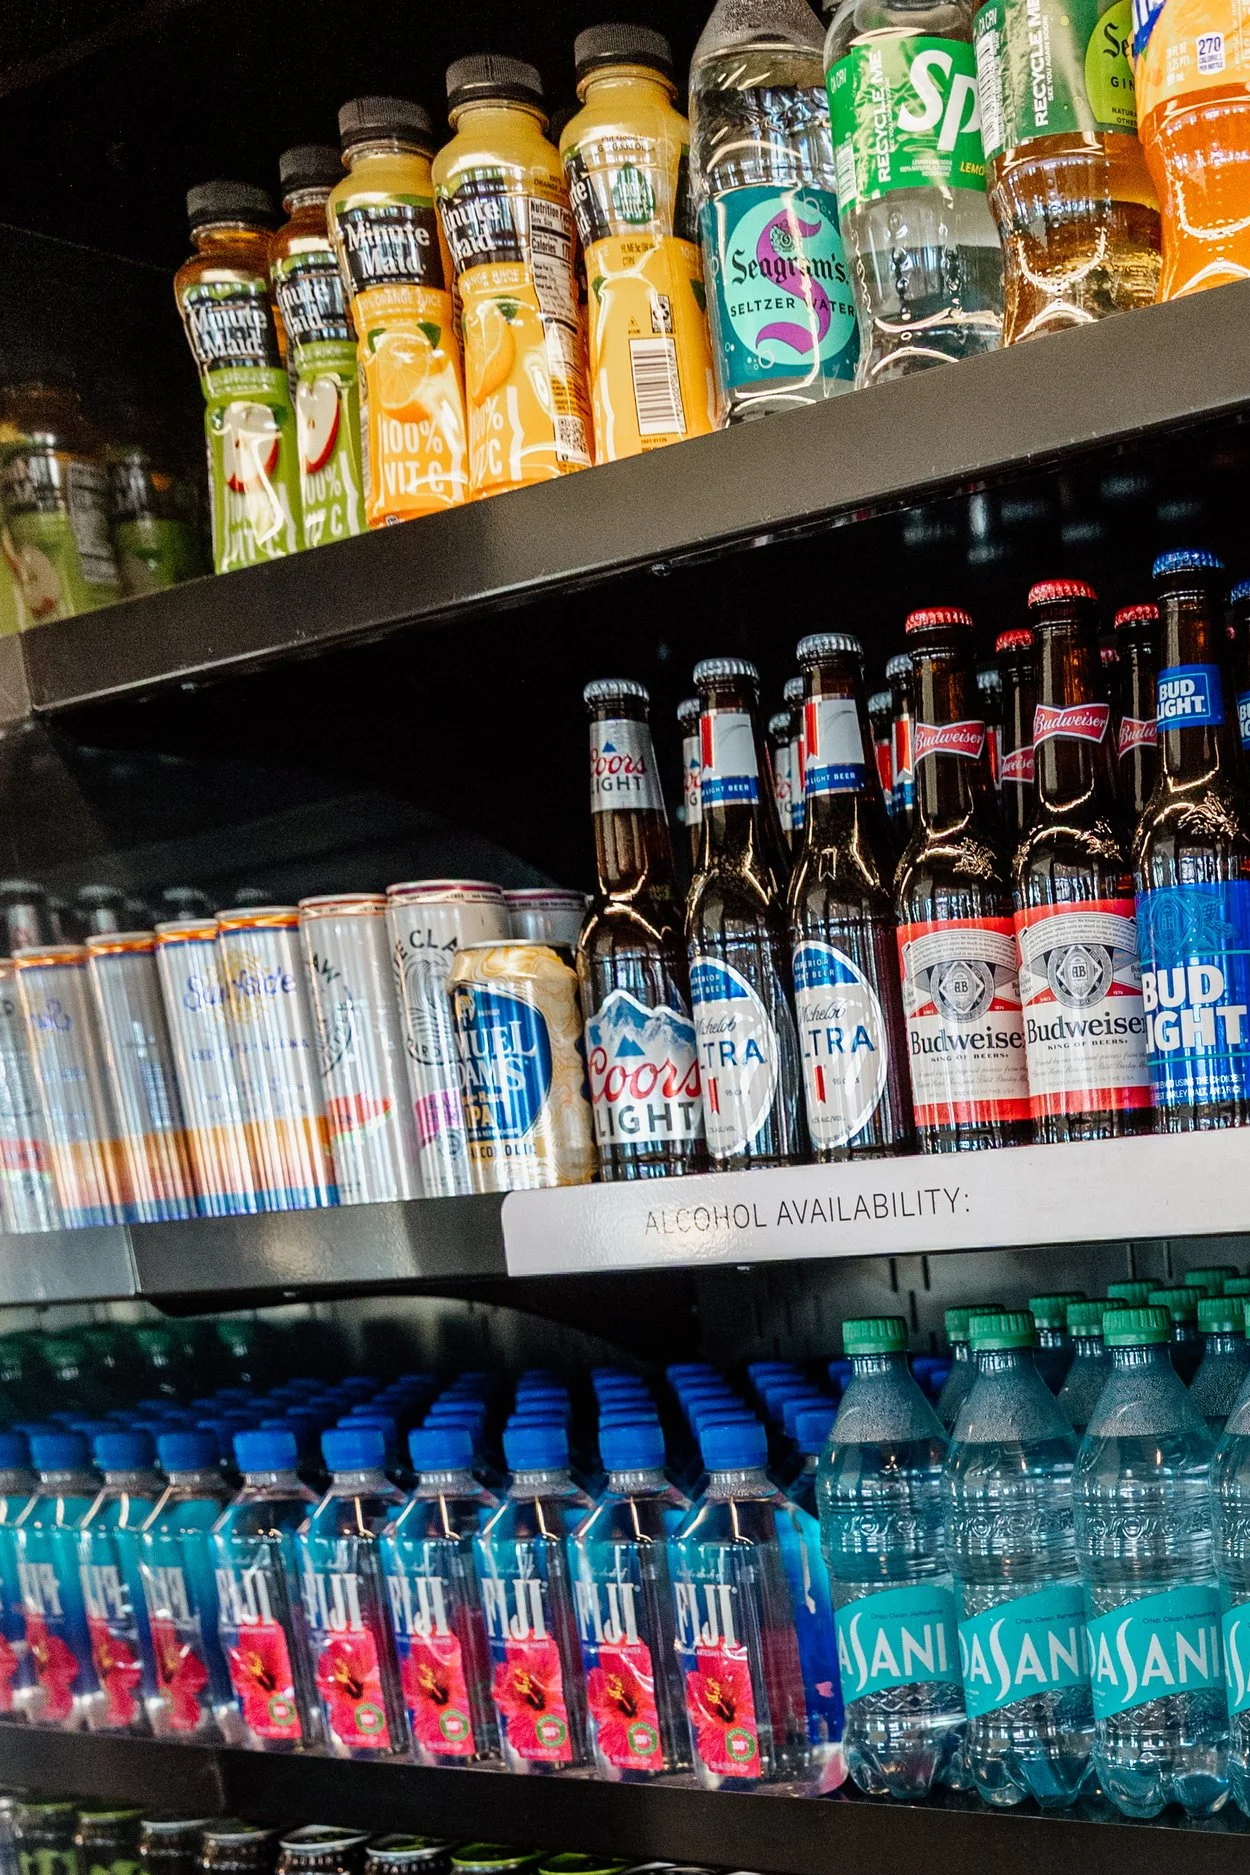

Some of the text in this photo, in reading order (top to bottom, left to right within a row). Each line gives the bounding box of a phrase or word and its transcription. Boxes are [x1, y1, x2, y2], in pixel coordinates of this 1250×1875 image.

[1198, 36, 1222, 56] 270
[1028, 30, 1049, 127] RECYCLE
[869, 50, 892, 183] RECYCLE ME
[344, 220, 430, 252] Minute
[730, 296, 856, 319] SELTZER WATER
[383, 419, 443, 455] 100%
[384, 462, 420, 496] VIT
[1159, 679, 1195, 698] BUD
[915, 728, 984, 751] Budweiser
[1036, 711, 1107, 734] Budweiser
[834, 772, 856, 782] BEER
[1141, 965, 1225, 1013] BUD
[587, 1046, 701, 1104] Coors
[596, 1101, 695, 1138] LIGHT
[645, 1187, 969, 1235] ALCOHOL AVAILABILITY:
[387, 1576, 448, 1638] FIJI
[481, 1578, 547, 1640] FIJI
[574, 1581, 639, 1645] FIJI
